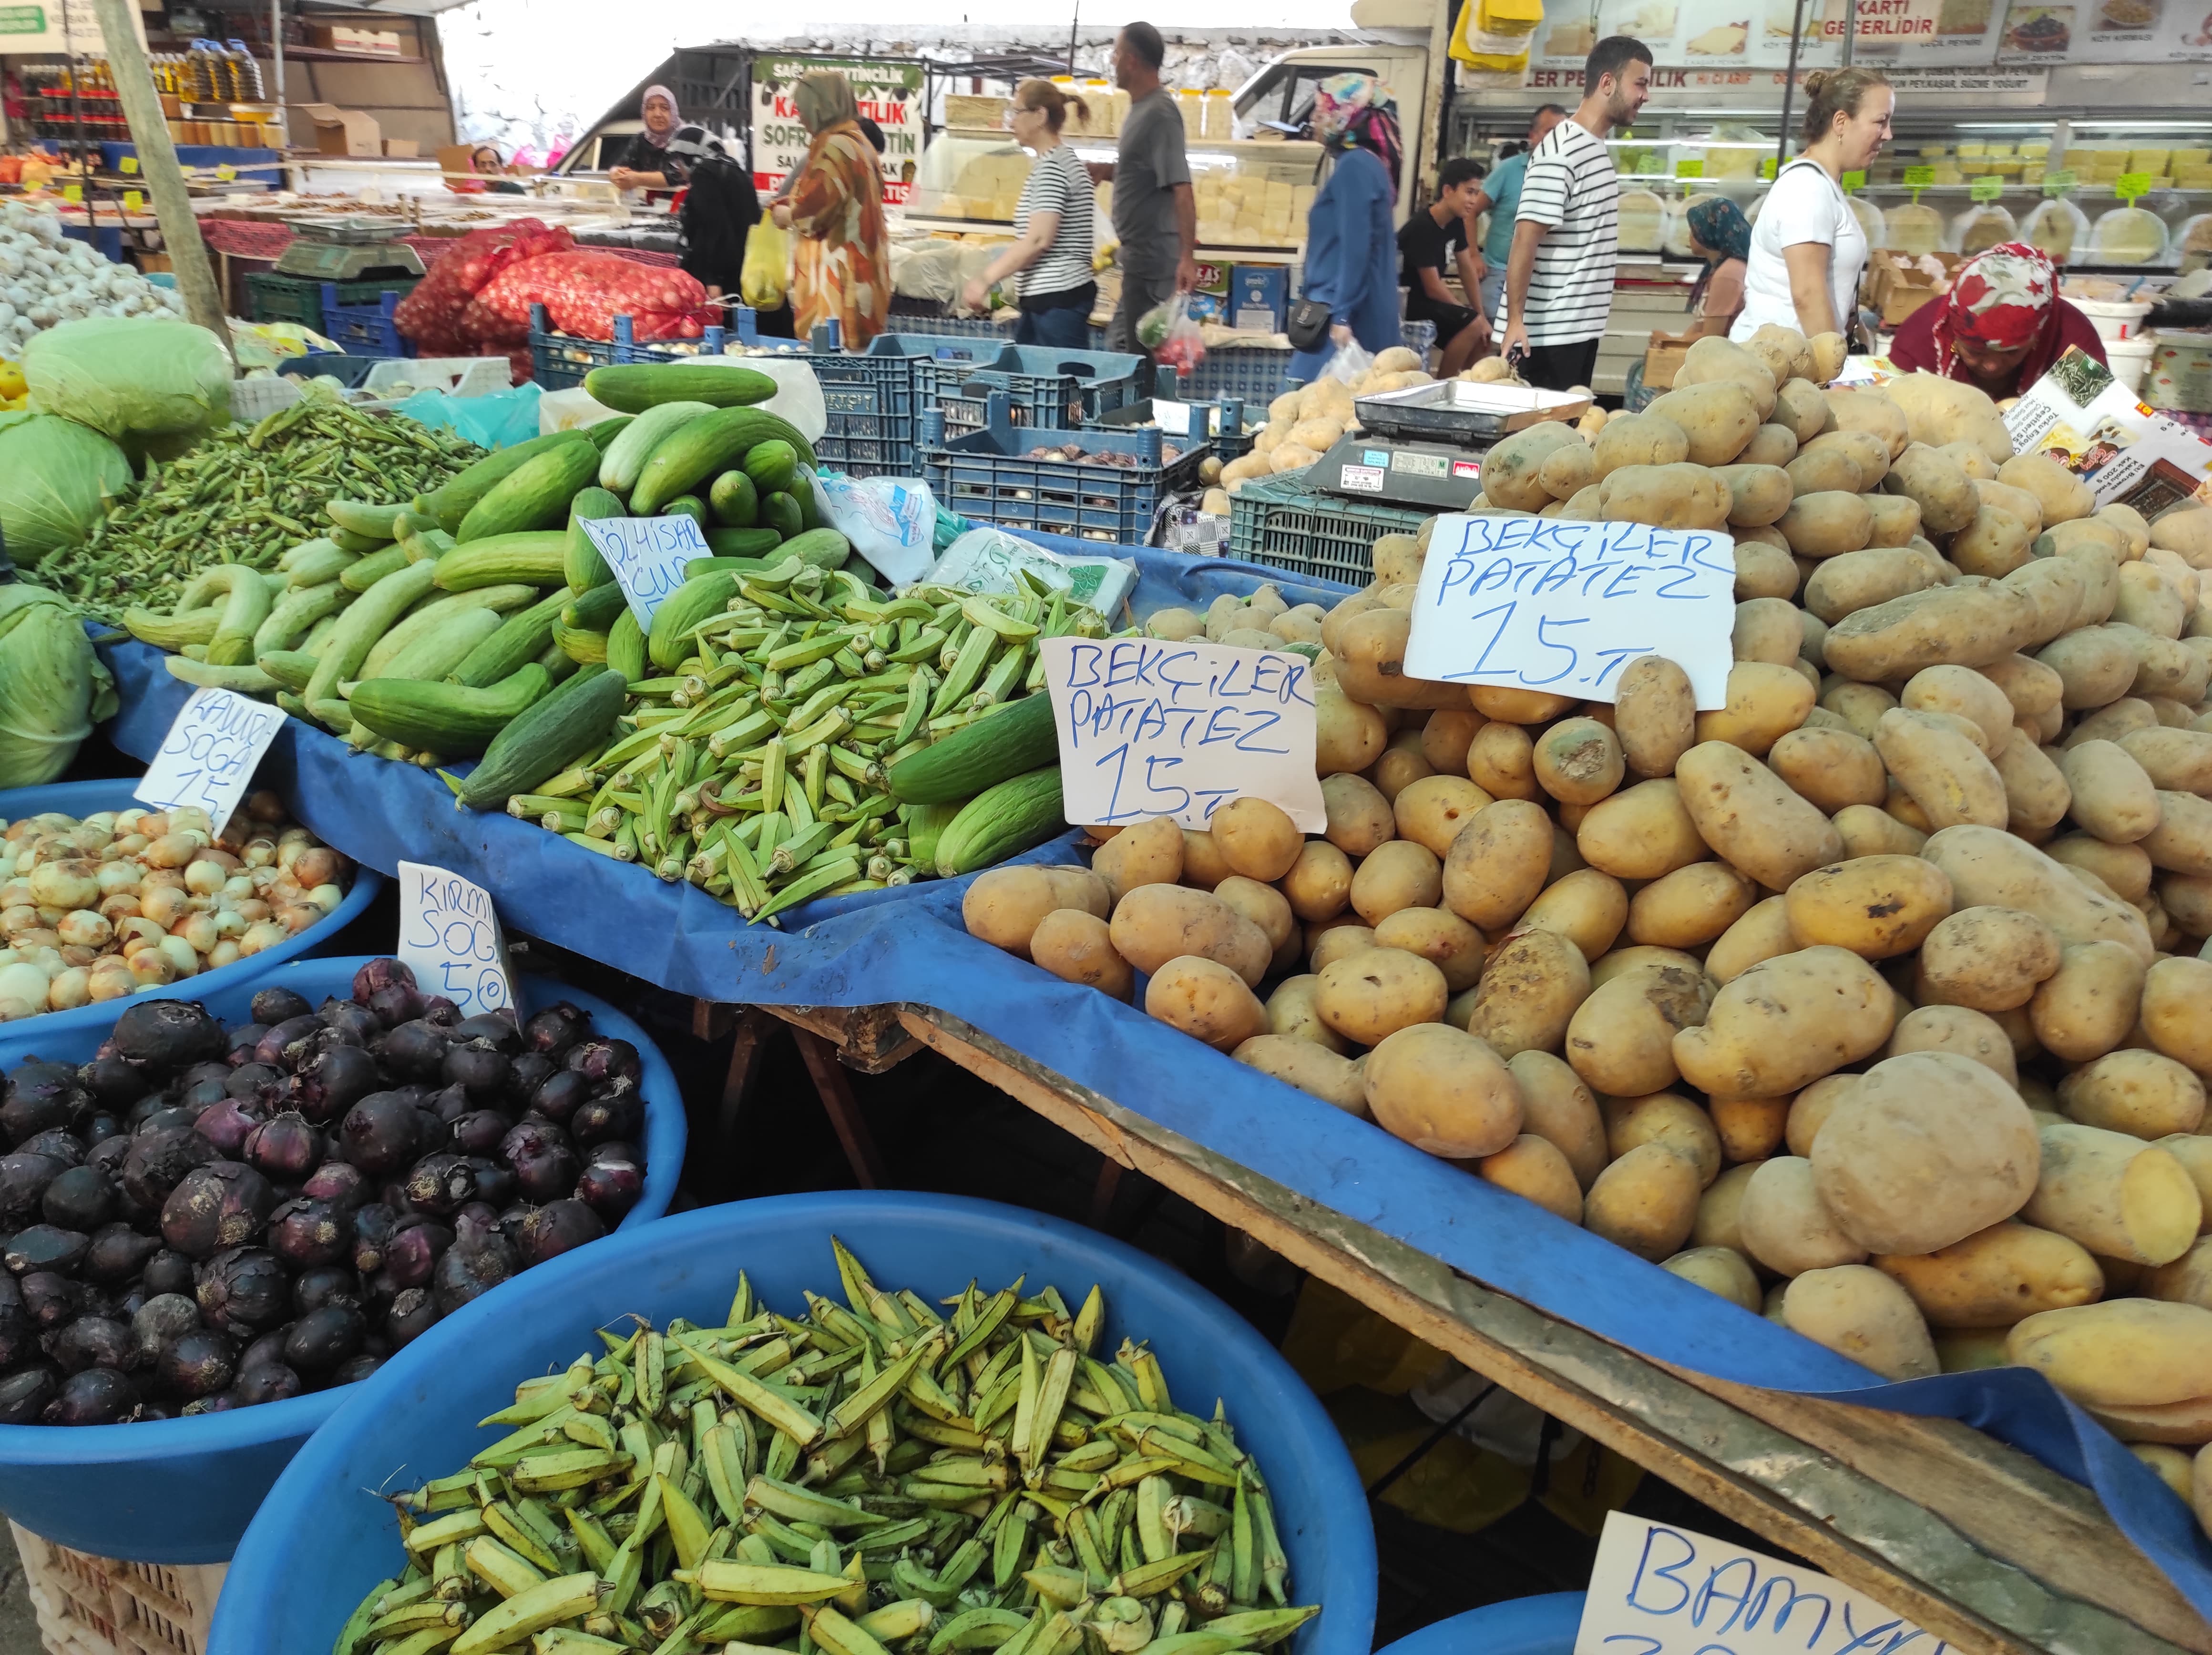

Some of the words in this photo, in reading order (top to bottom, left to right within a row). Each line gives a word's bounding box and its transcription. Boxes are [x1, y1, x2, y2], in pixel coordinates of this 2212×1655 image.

[2021, 405, 2051, 434] Çeşitleri
[2037, 411, 2059, 431] Torku
[2018, 428, 2039, 448] Enjoy
[2102, 467, 2117, 480] 200
[1437, 556, 1710, 606] PATATEZ
[1070, 689, 1290, 754] PATATEZ
